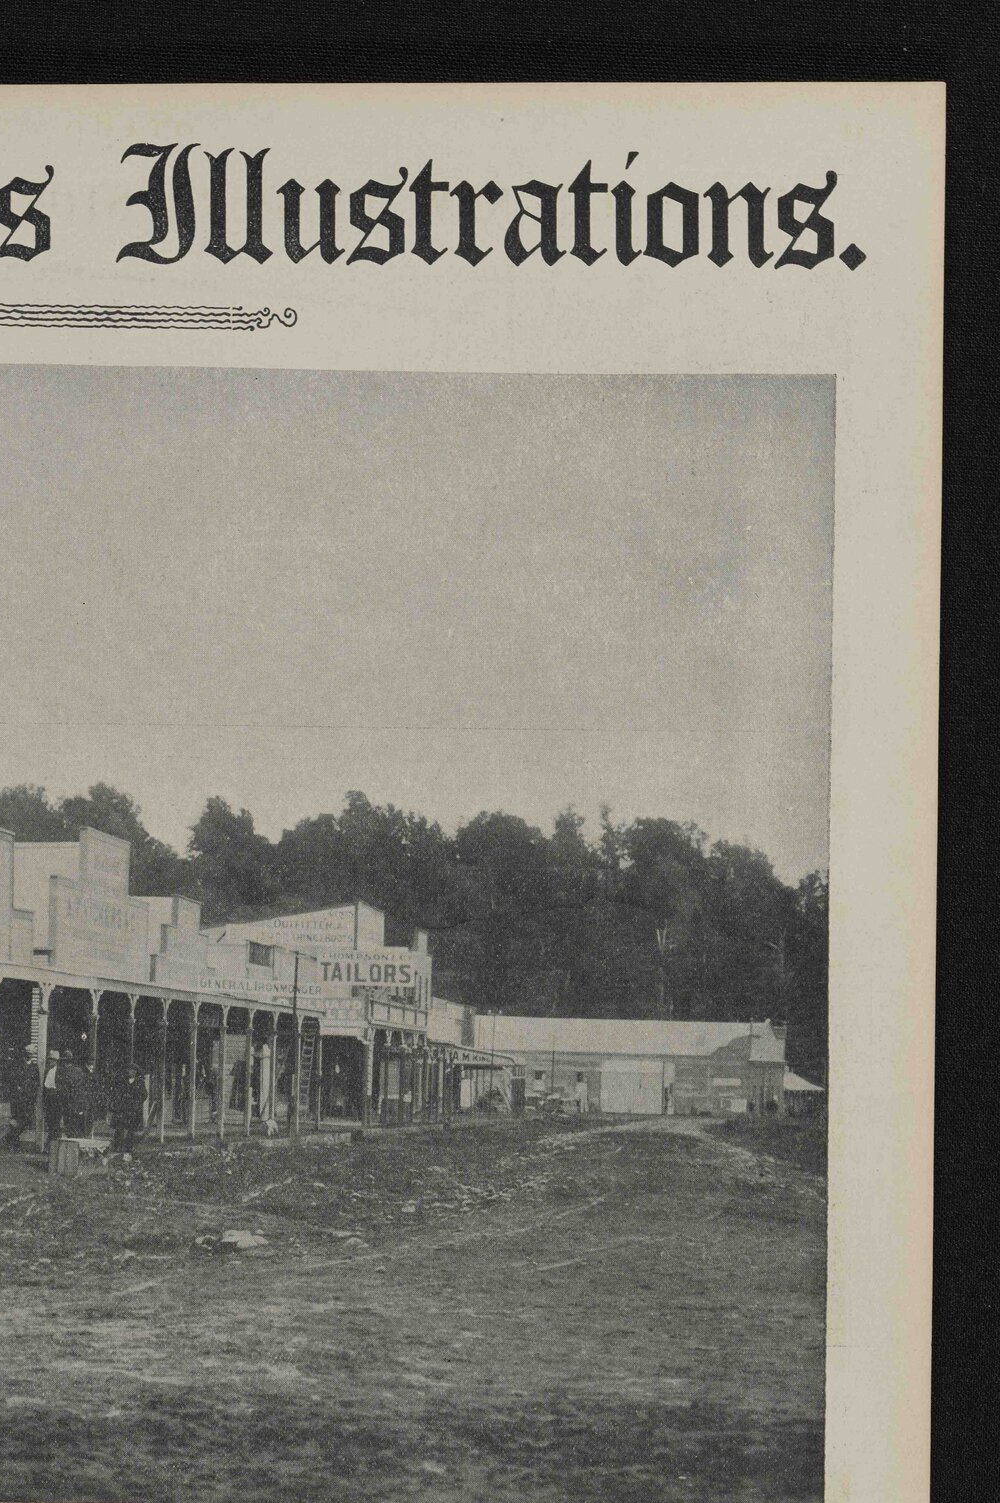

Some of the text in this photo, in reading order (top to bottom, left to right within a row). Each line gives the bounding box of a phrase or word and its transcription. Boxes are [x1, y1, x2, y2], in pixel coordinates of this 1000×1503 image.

[116, 143, 866, 271] Illustrations.
[319, 961, 411, 984] TAILORS
[200, 977, 253, 992] GENERAL
